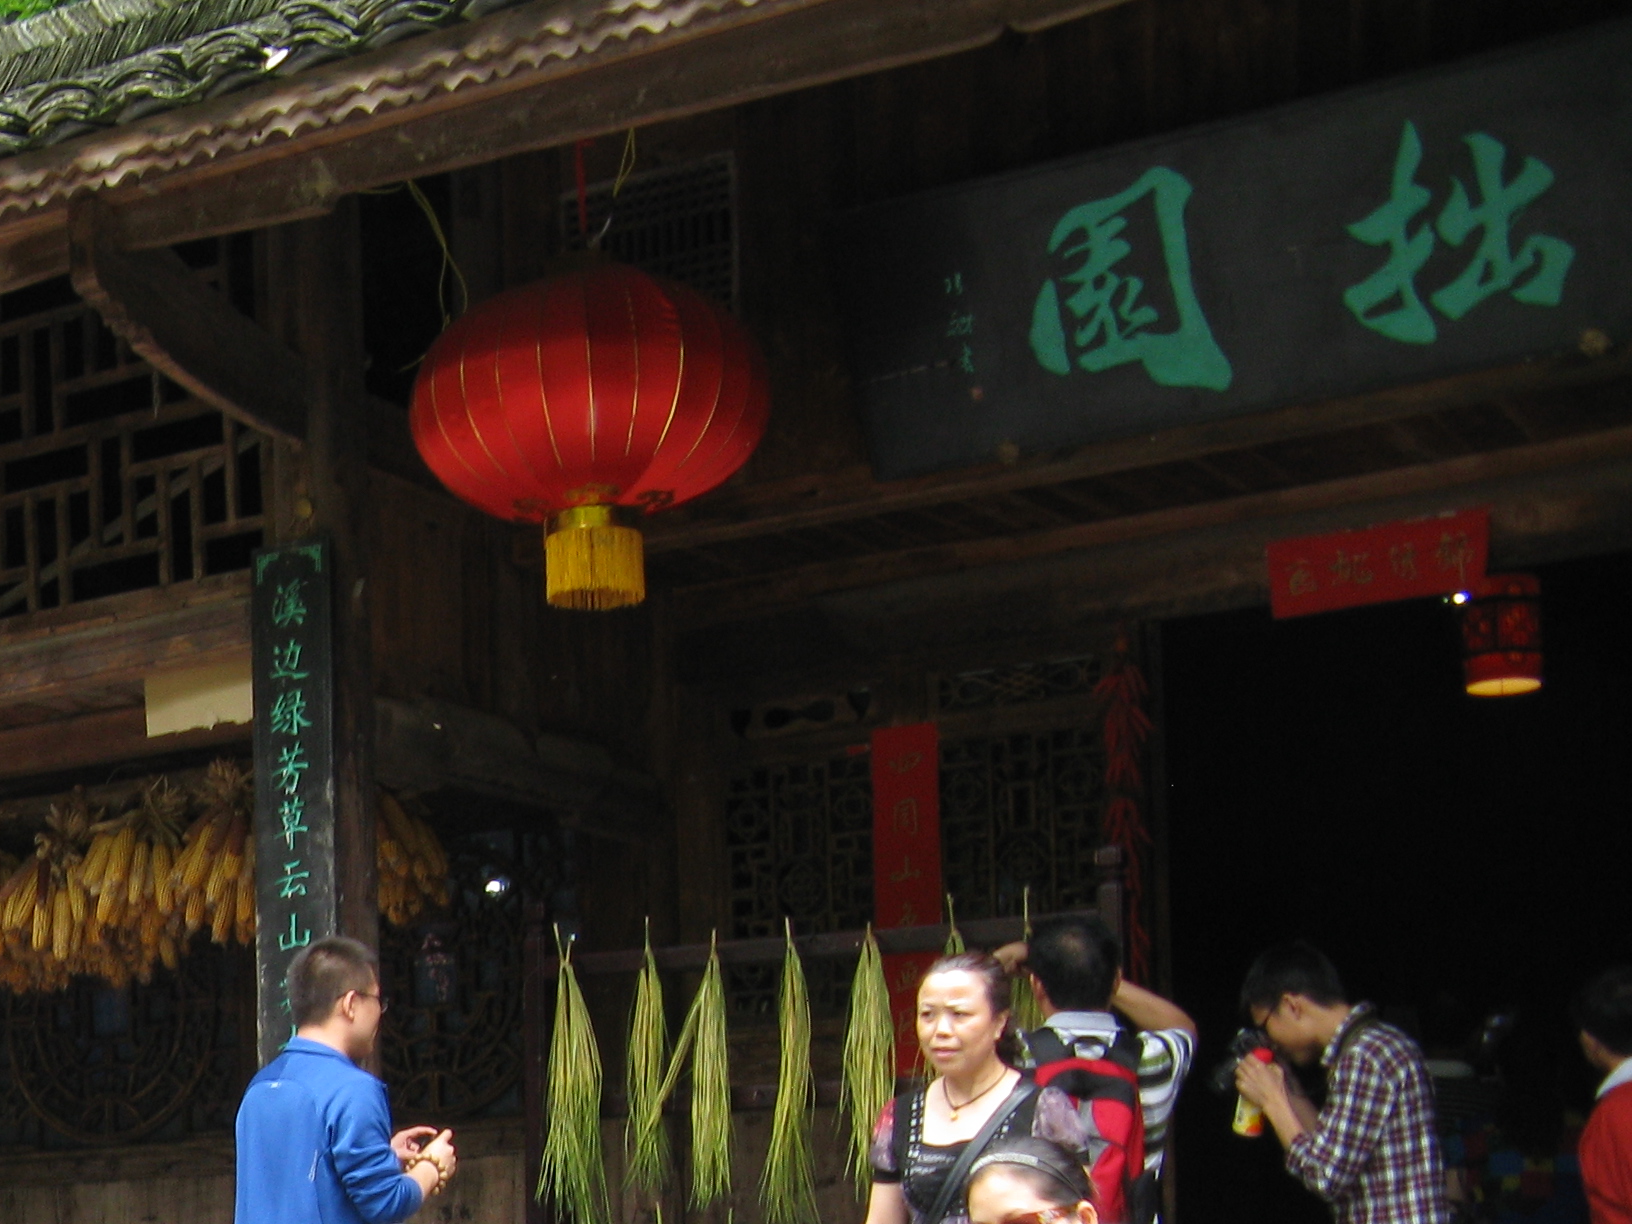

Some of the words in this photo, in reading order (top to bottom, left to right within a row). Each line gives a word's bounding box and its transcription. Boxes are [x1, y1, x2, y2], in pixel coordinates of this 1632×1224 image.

[270, 578, 314, 1050] 溪边绿芳草云山
